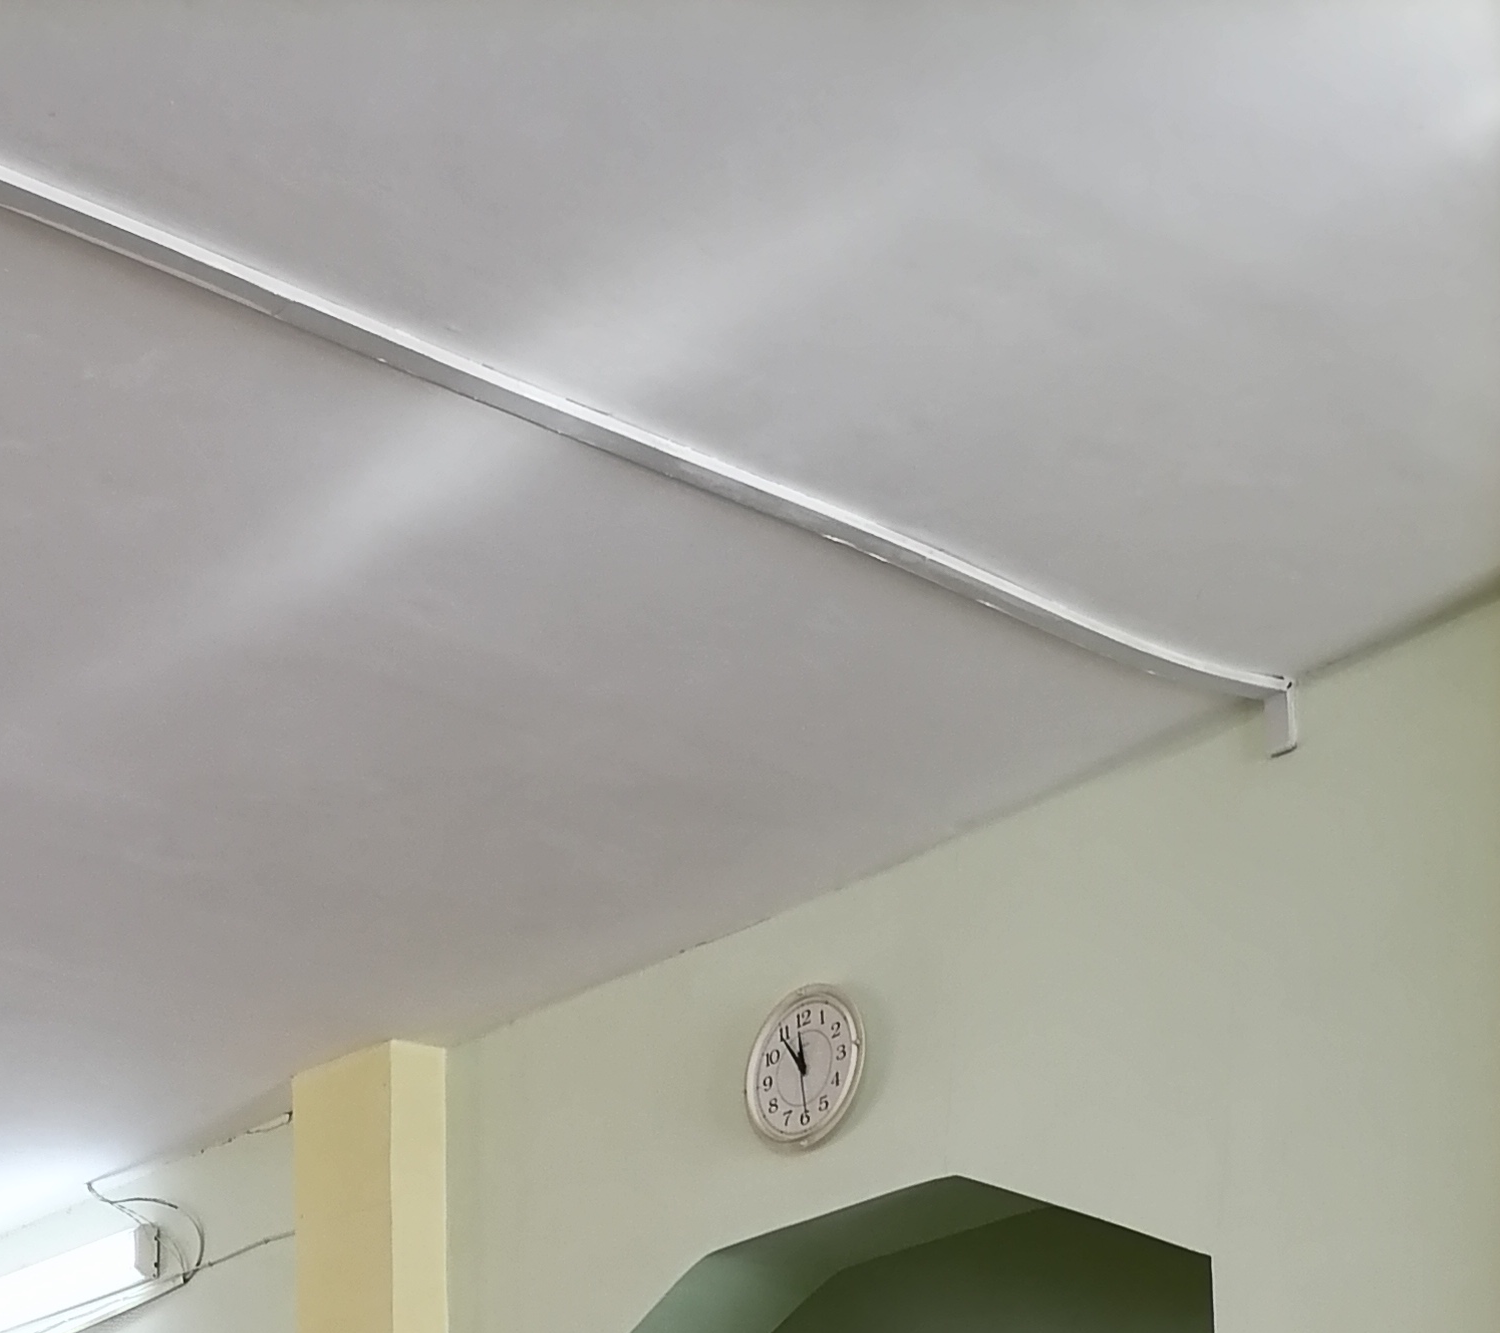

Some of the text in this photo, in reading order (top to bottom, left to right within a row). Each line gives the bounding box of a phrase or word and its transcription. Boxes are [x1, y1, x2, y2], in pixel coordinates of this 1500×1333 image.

[796, 1009, 811, 1028] 12
[819, 1009, 825, 1025] 1
[831, 1022, 841, 1039] 2
[765, 1049, 780, 1067] 10
[836, 1044, 847, 1061] 3
[763, 1076, 773, 1092] 9
[830, 1071, 840, 1086] 4
[768, 1098, 779, 1114] 8
[818, 1095, 829, 1112] 5
[782, 1109, 793, 1126] 7
[800, 1109, 811, 1126] 6
